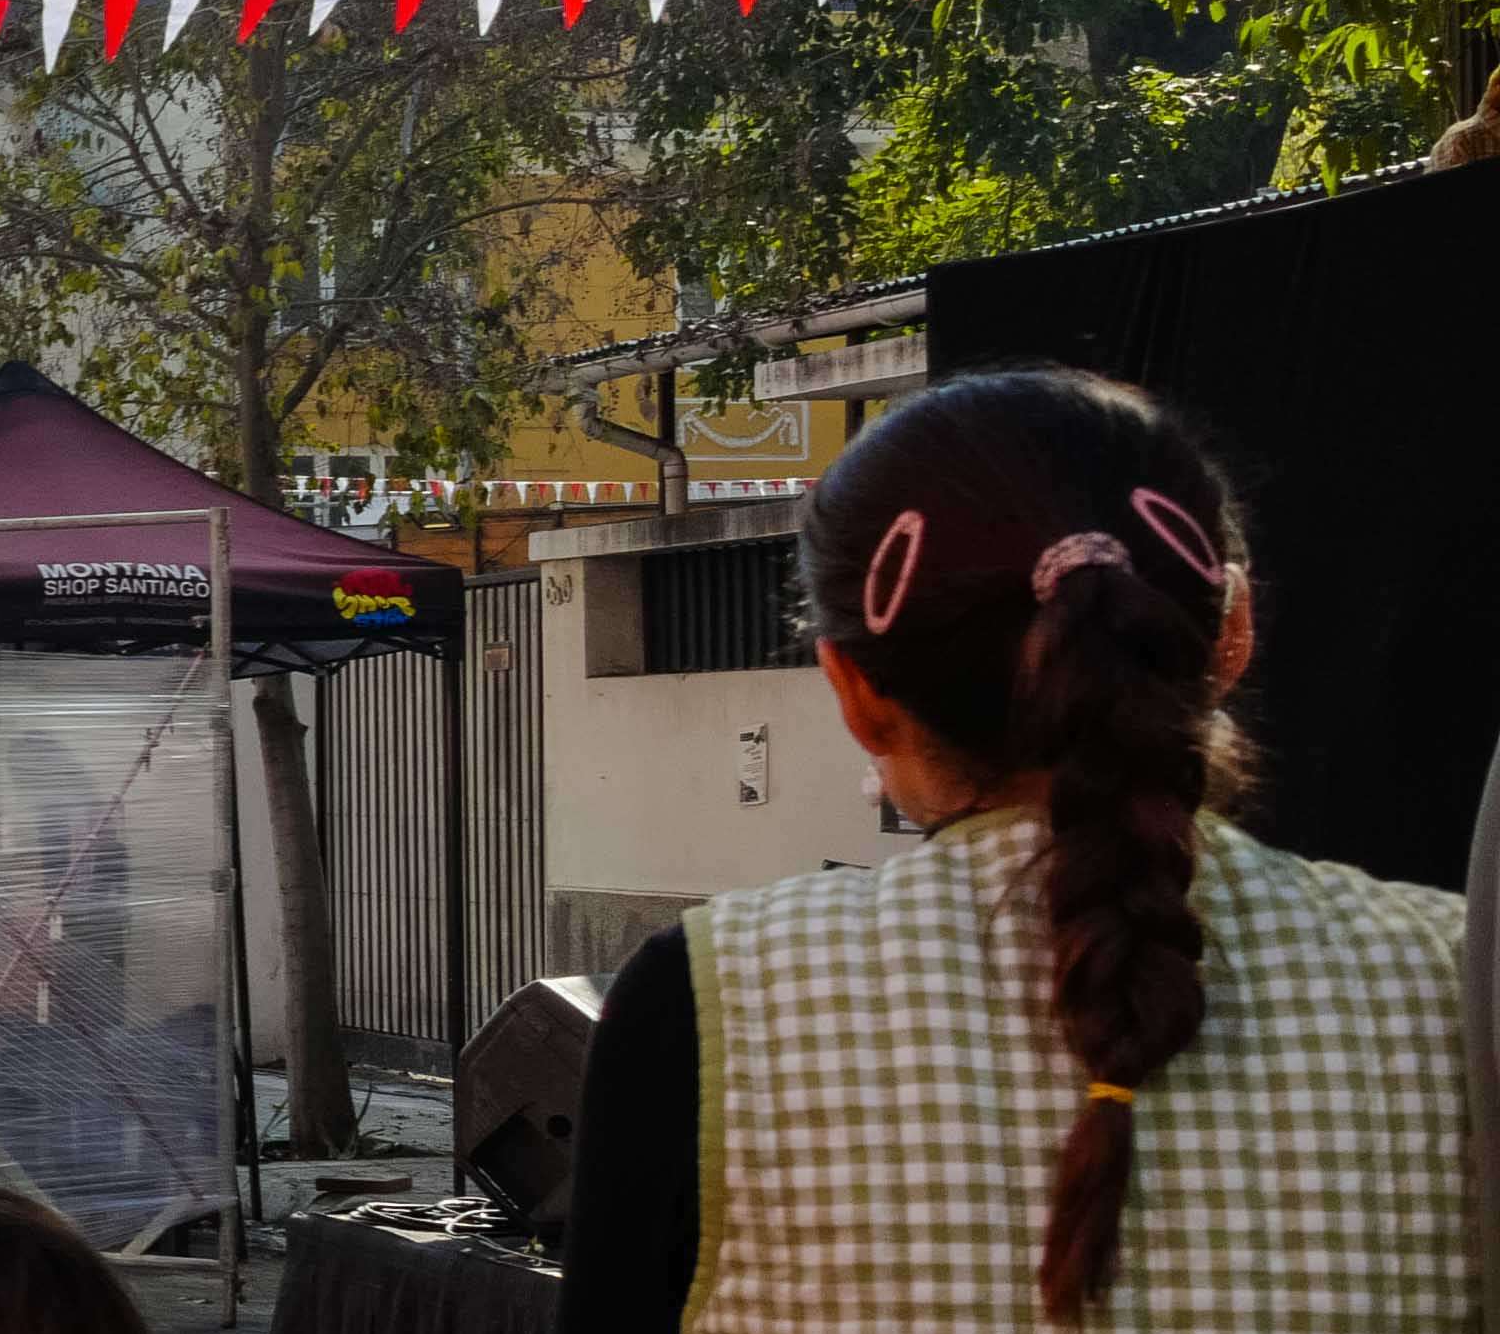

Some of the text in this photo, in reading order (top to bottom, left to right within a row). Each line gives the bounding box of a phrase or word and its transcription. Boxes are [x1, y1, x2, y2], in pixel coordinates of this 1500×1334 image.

[36, 562, 208, 581] MONTANA
[43, 577, 211, 598] SHOP SANTIAGO
